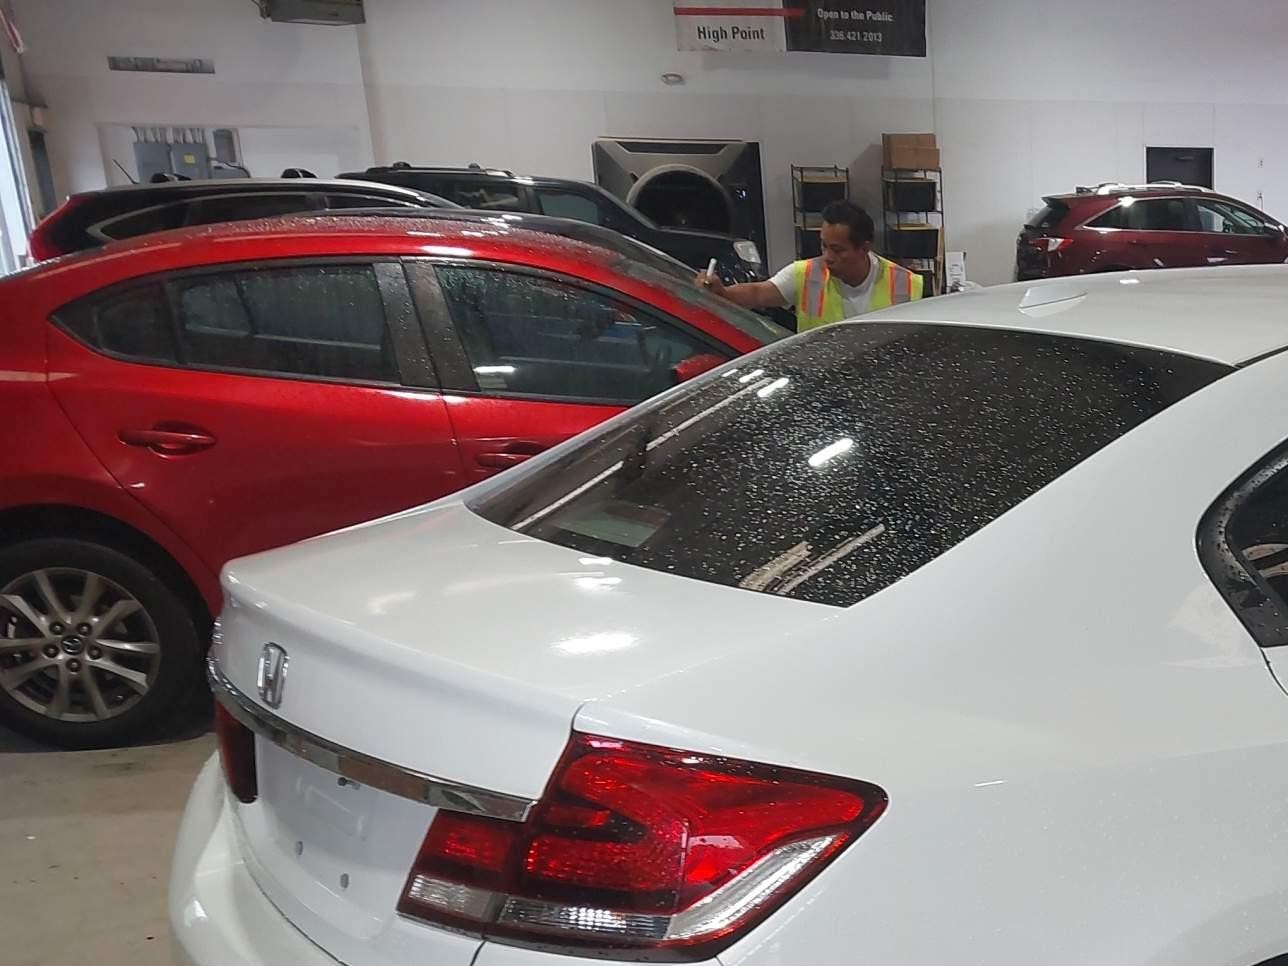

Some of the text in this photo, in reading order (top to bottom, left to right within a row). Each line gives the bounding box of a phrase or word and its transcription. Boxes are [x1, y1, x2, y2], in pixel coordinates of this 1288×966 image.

[817, 8, 894, 22] Open to the Public
[697, 26, 766, 43] High Point
